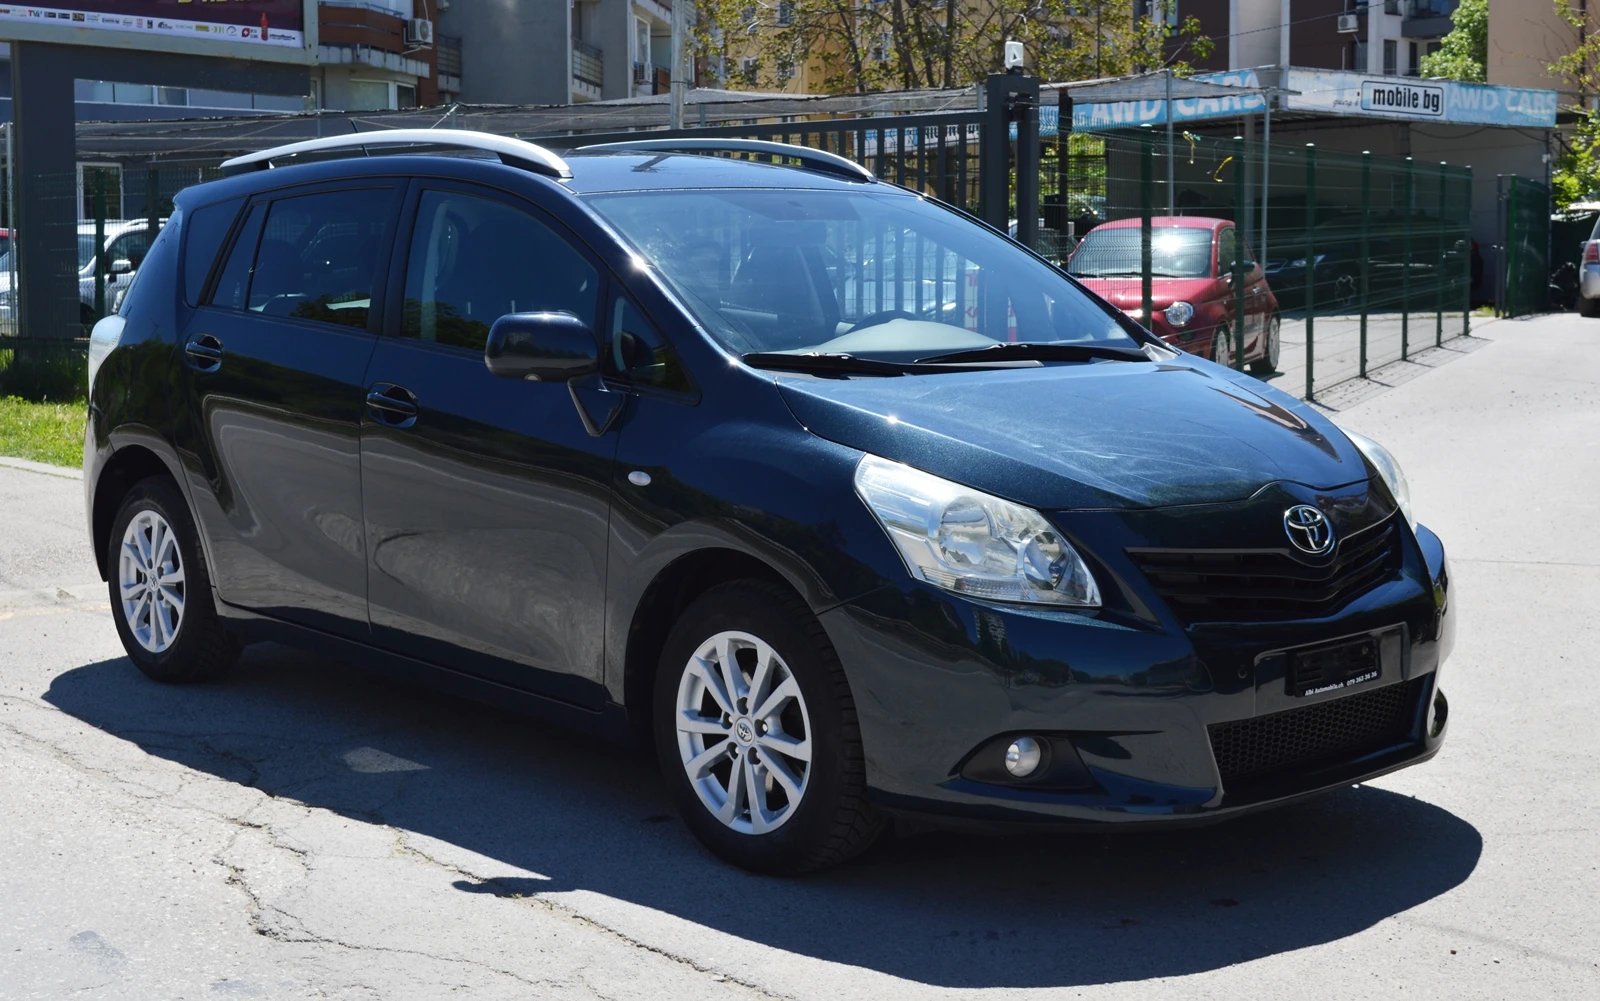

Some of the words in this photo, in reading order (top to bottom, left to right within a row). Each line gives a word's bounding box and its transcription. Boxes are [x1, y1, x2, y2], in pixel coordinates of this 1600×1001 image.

[1373, 86, 1419, 108] mobile
[1423, 90, 1440, 112] bg
[1449, 86, 1498, 111] AWD
[1505, 90, 1556, 114] CARS
